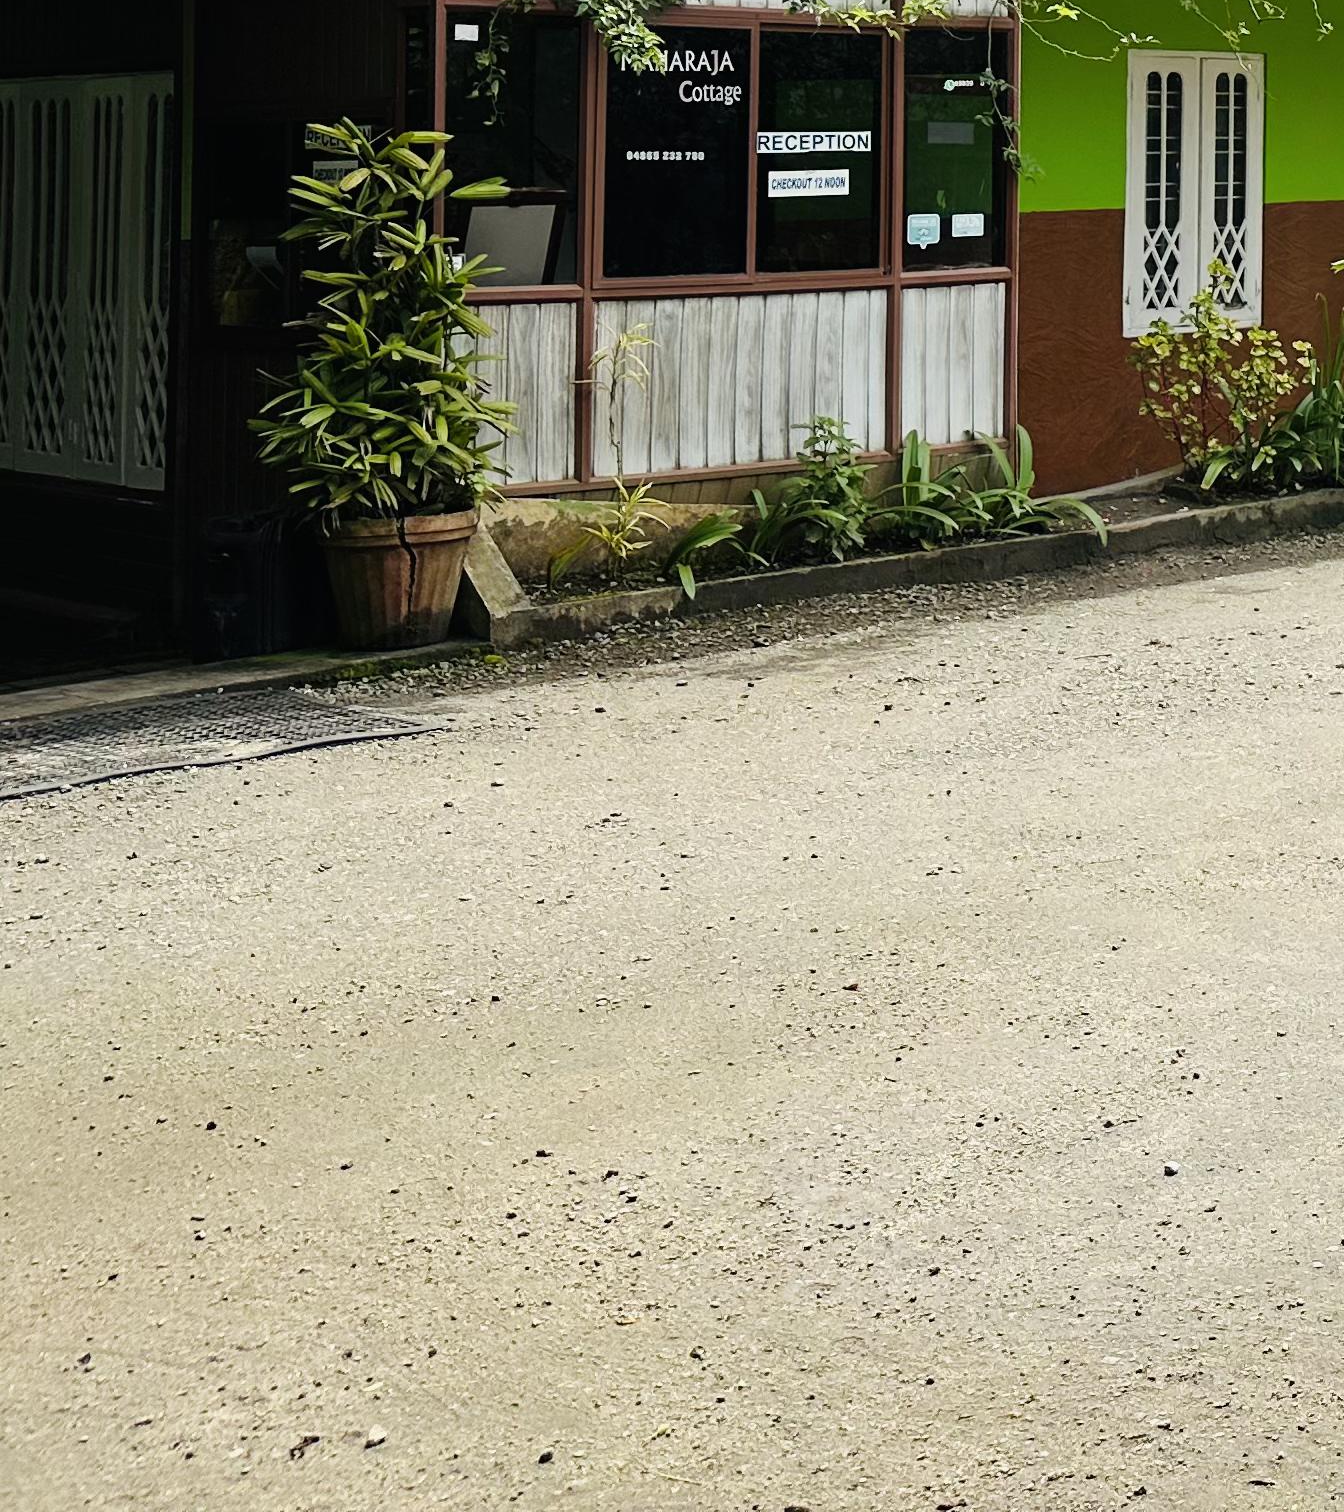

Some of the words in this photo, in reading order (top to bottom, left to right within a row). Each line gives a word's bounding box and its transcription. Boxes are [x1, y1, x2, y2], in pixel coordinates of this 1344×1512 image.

[679, 80, 742, 106] Cottage
[758, 134, 869, 150] RECEPTION
[771, 177, 812, 190] CHECKOUT
[814, 178, 823, 189] 12
[824, 176, 846, 188] NOON
